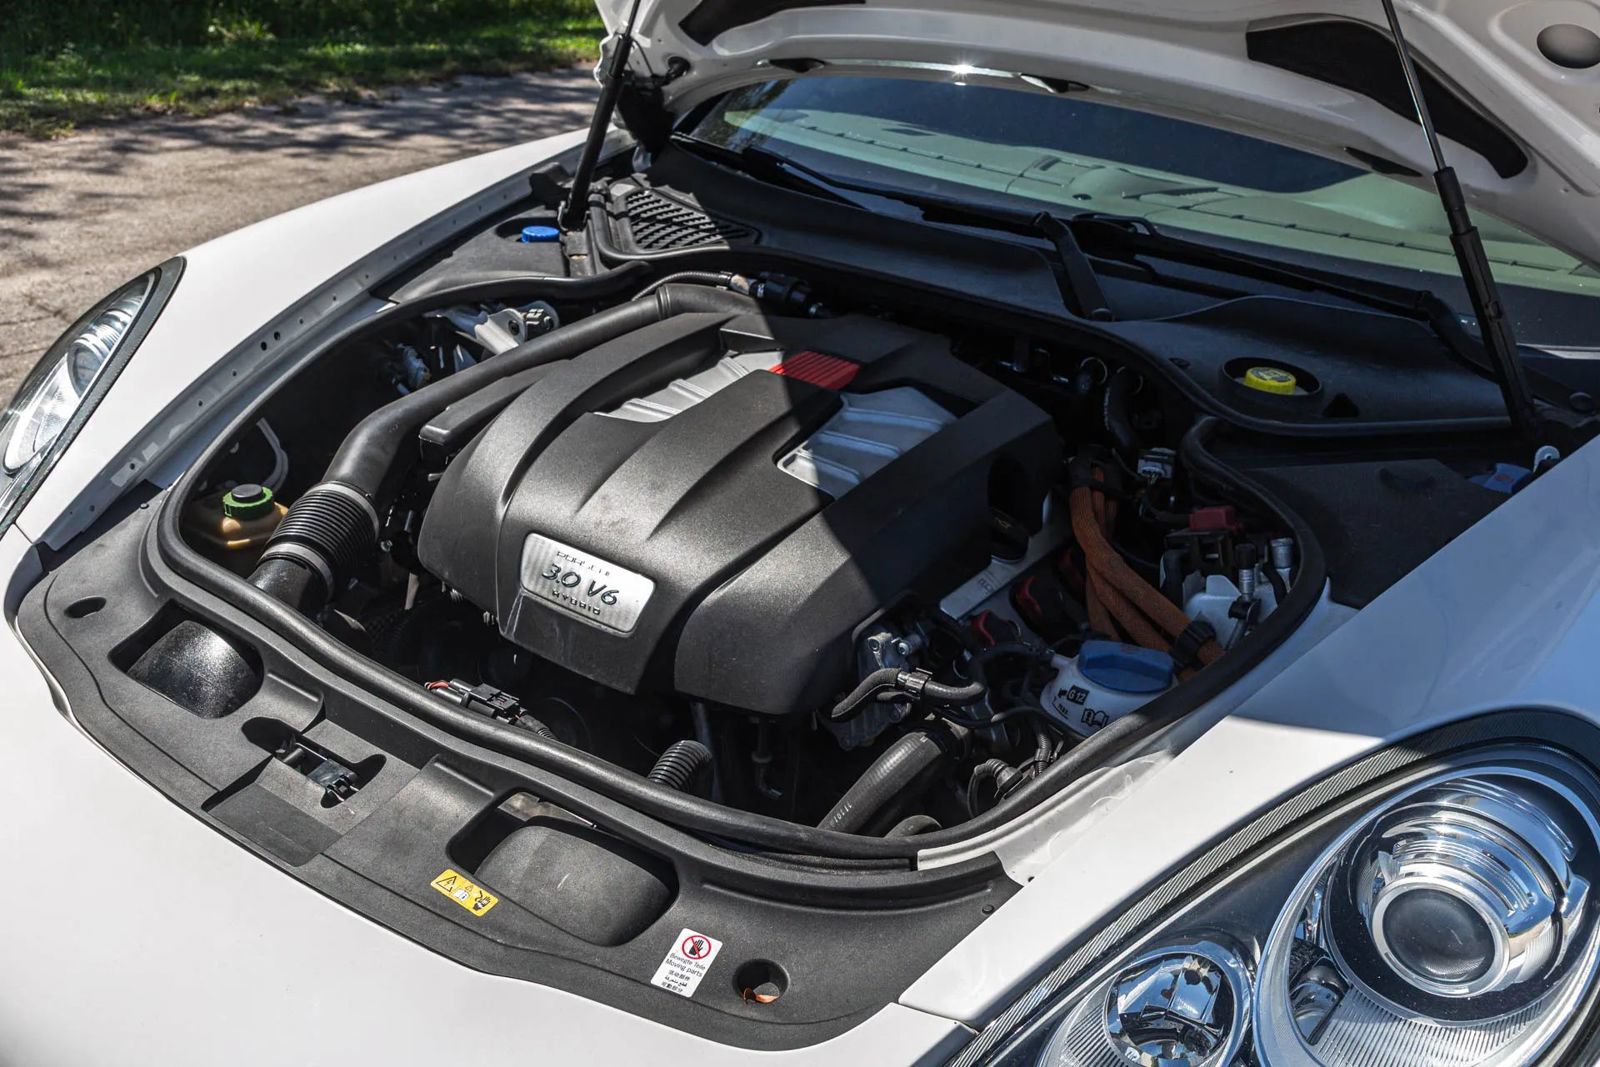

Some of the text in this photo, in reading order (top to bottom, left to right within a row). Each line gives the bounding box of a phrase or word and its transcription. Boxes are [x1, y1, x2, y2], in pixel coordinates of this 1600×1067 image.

[541, 563, 620, 606] 3.0 V6
[665, 959, 703, 977] Moving parts
